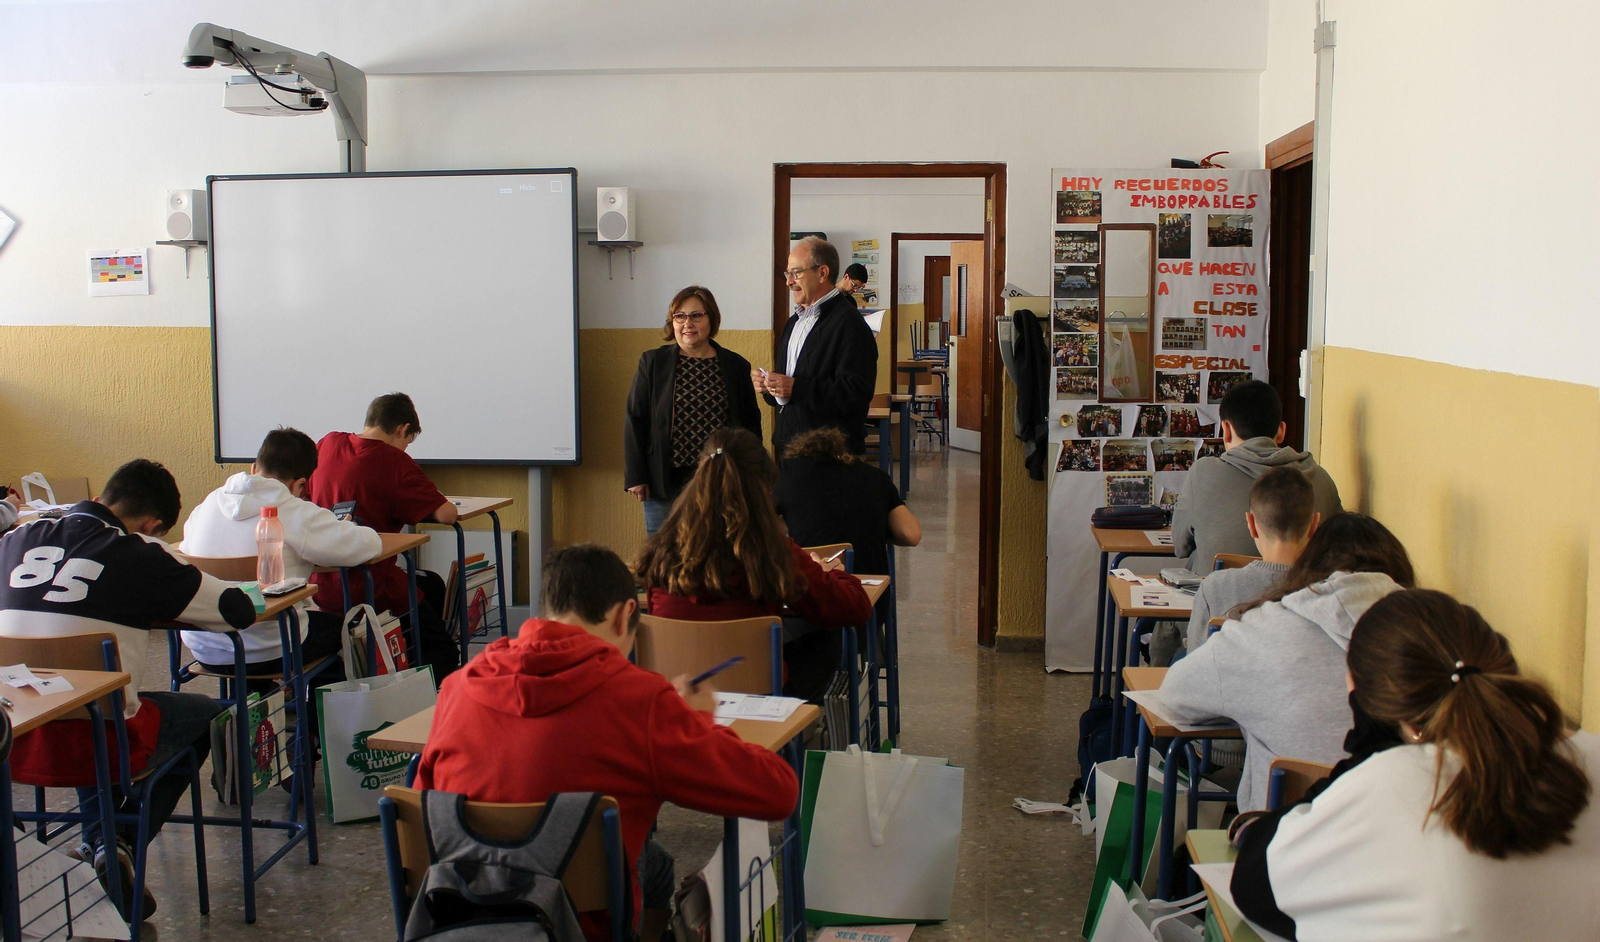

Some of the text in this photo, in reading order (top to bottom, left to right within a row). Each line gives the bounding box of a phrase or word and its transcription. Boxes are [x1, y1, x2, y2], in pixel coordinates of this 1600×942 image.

[1062, 177, 1229, 192] HAY RECUERDOS
[1130, 194, 1258, 209] IMBORRABLES
[1157, 262, 1256, 276] QUE HACEN
[1158, 281, 1258, 296] A ESTA
[1193, 301, 1258, 316] CLASE
[1212, 324, 1246, 338] TAN
[1154, 354, 1250, 370] ESPECIAL
[9, 546, 105, 603] 85
[367, 753, 410, 769] futuro
[361, 775, 380, 790] 40
[381, 774, 401, 784] GRUPO
